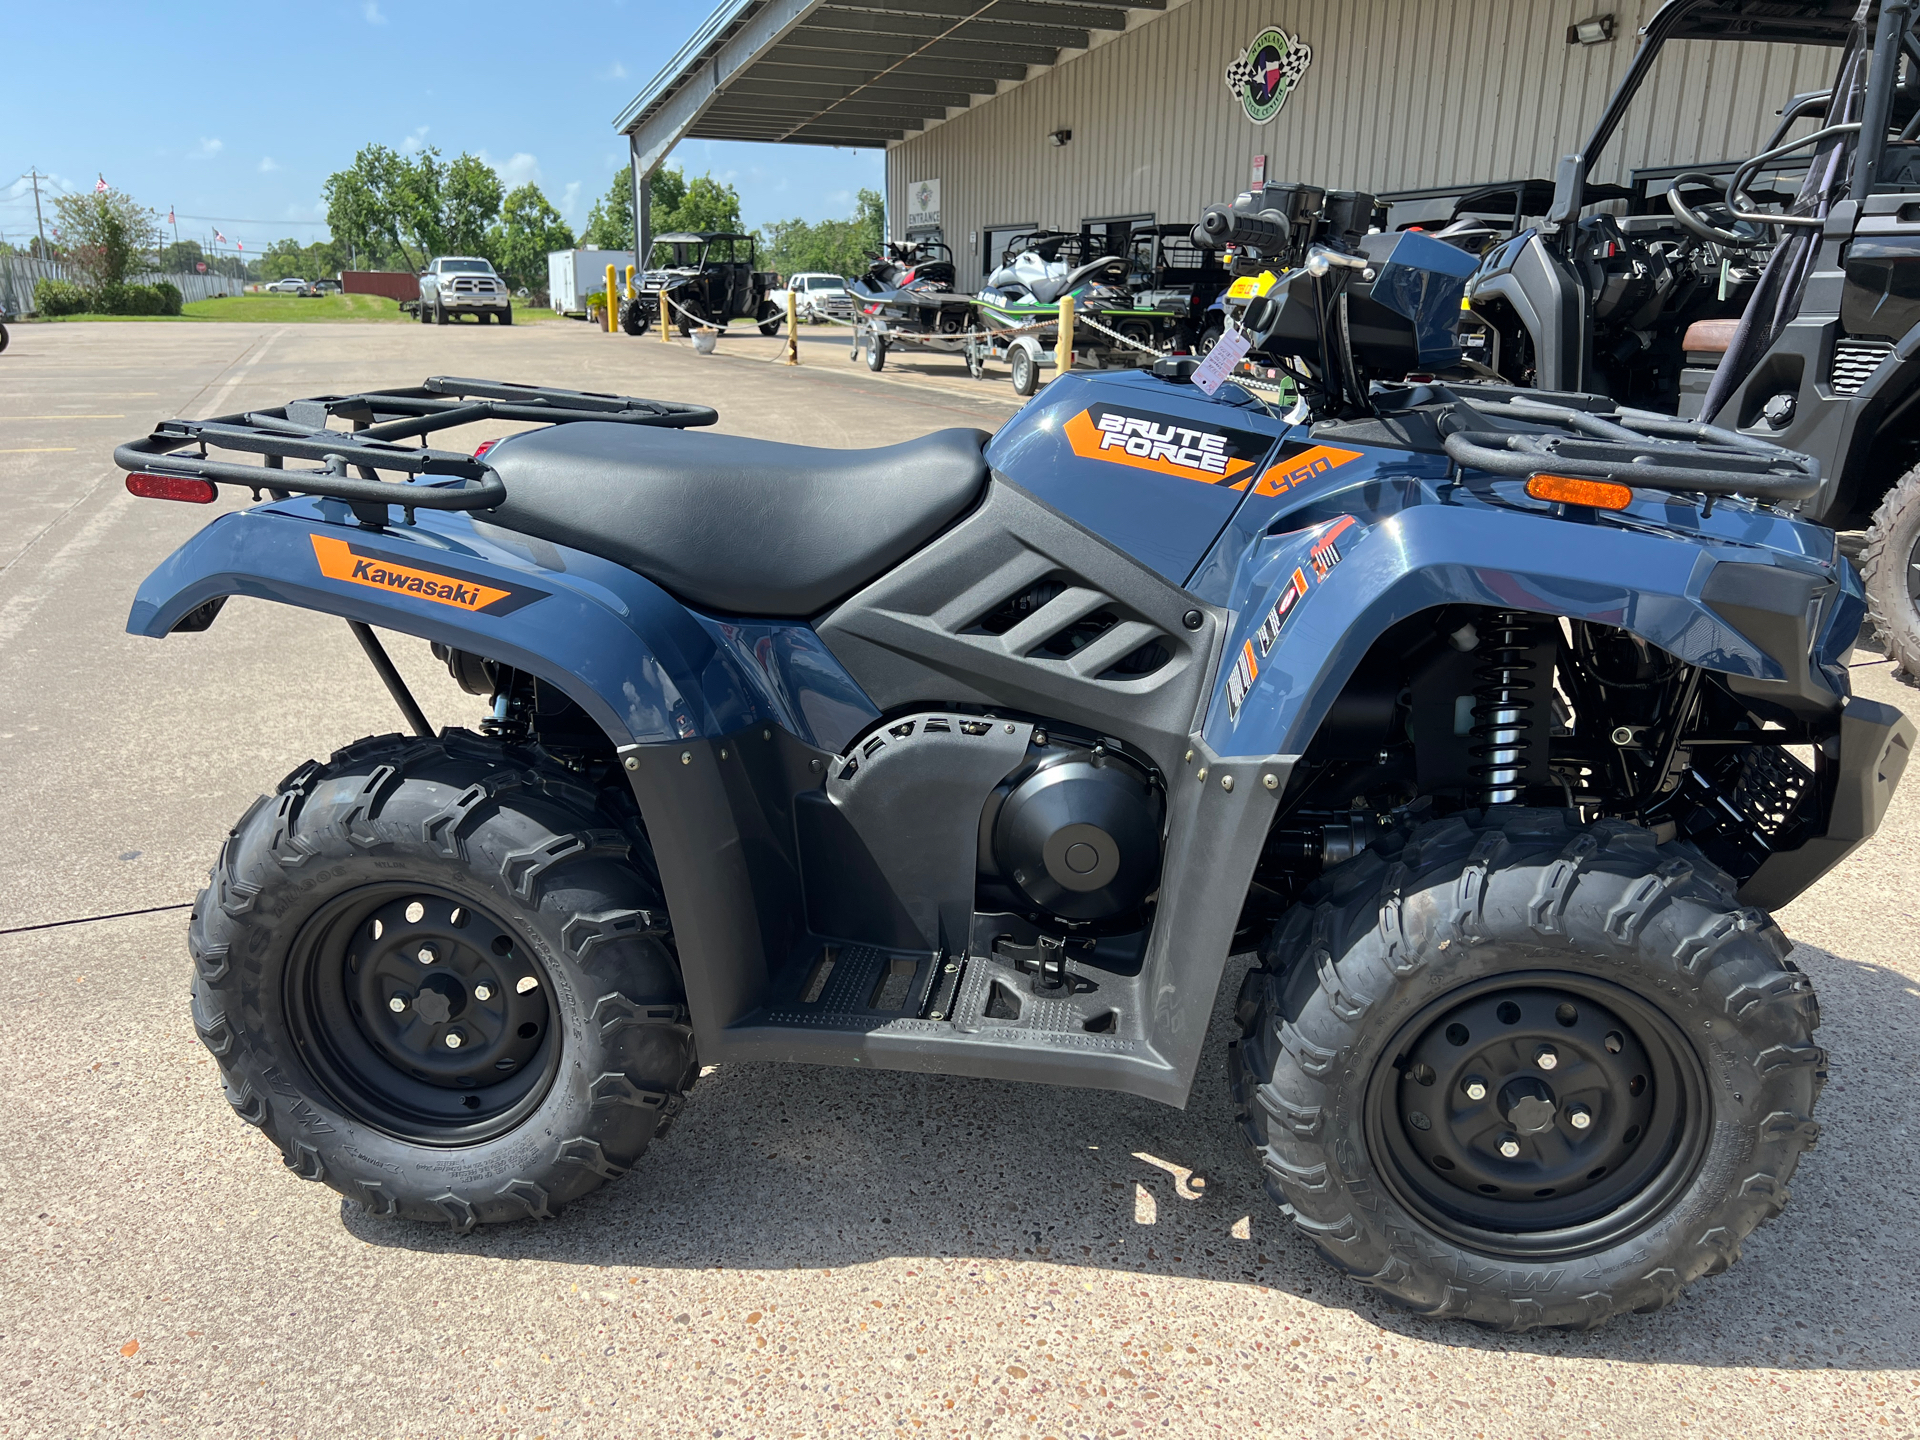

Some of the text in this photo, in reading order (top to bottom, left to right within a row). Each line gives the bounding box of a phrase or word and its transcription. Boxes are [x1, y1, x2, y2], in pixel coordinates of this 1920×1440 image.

[1250, 34, 1284, 57] MAINLAND
[1245, 88, 1284, 116] CYCLE CENTER
[909, 210, 940, 225] ENTRANCE
[1097, 412, 1228, 454] BRUTE
[1100, 431, 1229, 475] FORCE
[1269, 456, 1334, 492] 450
[351, 559, 481, 606] Kawasaki
[239, 923, 336, 1133] MAXXIS
[1333, 1136, 1566, 1292] MAXXIS
